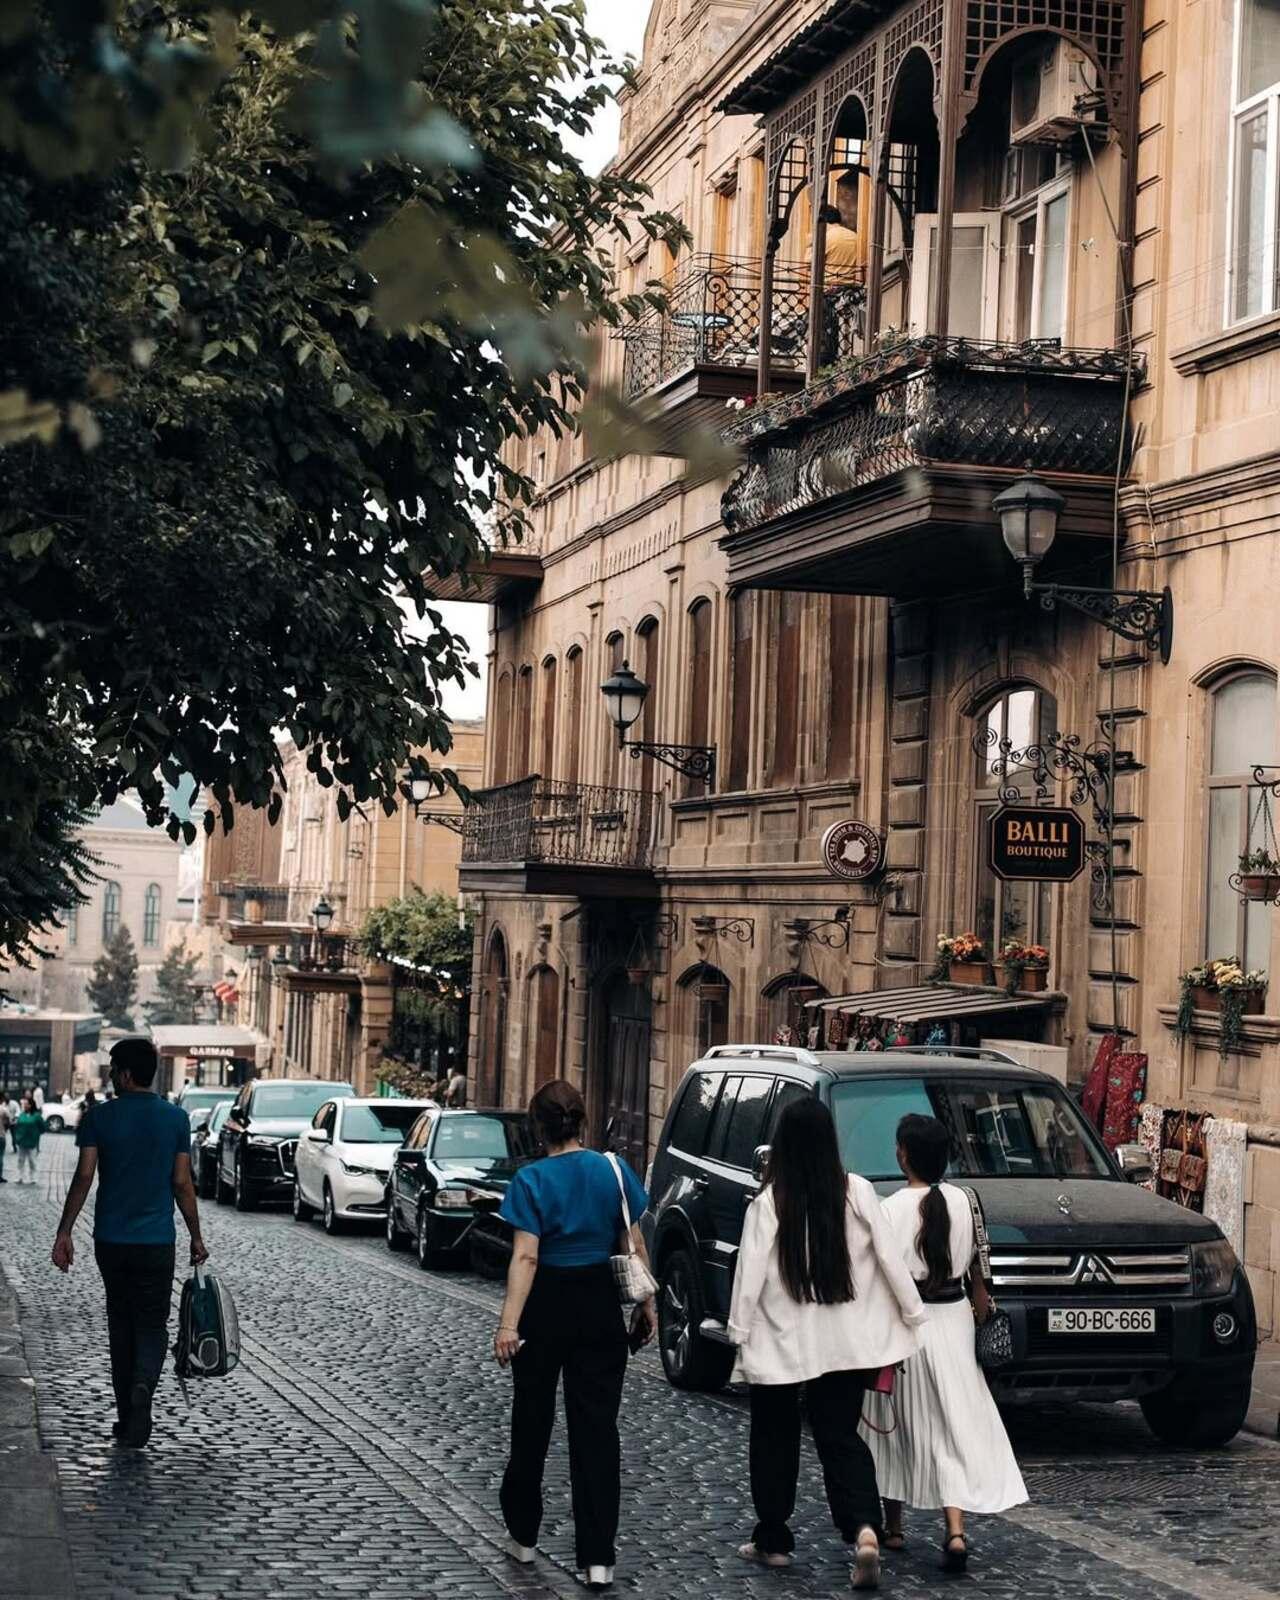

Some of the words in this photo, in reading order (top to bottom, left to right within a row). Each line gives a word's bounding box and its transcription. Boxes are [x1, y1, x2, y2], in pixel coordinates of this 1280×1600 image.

[1007, 820, 1069, 843] BALLI
[1007, 845, 1069, 858] BOUTIQUE
[1065, 1311, 1151, 1330] 90-BC-666
